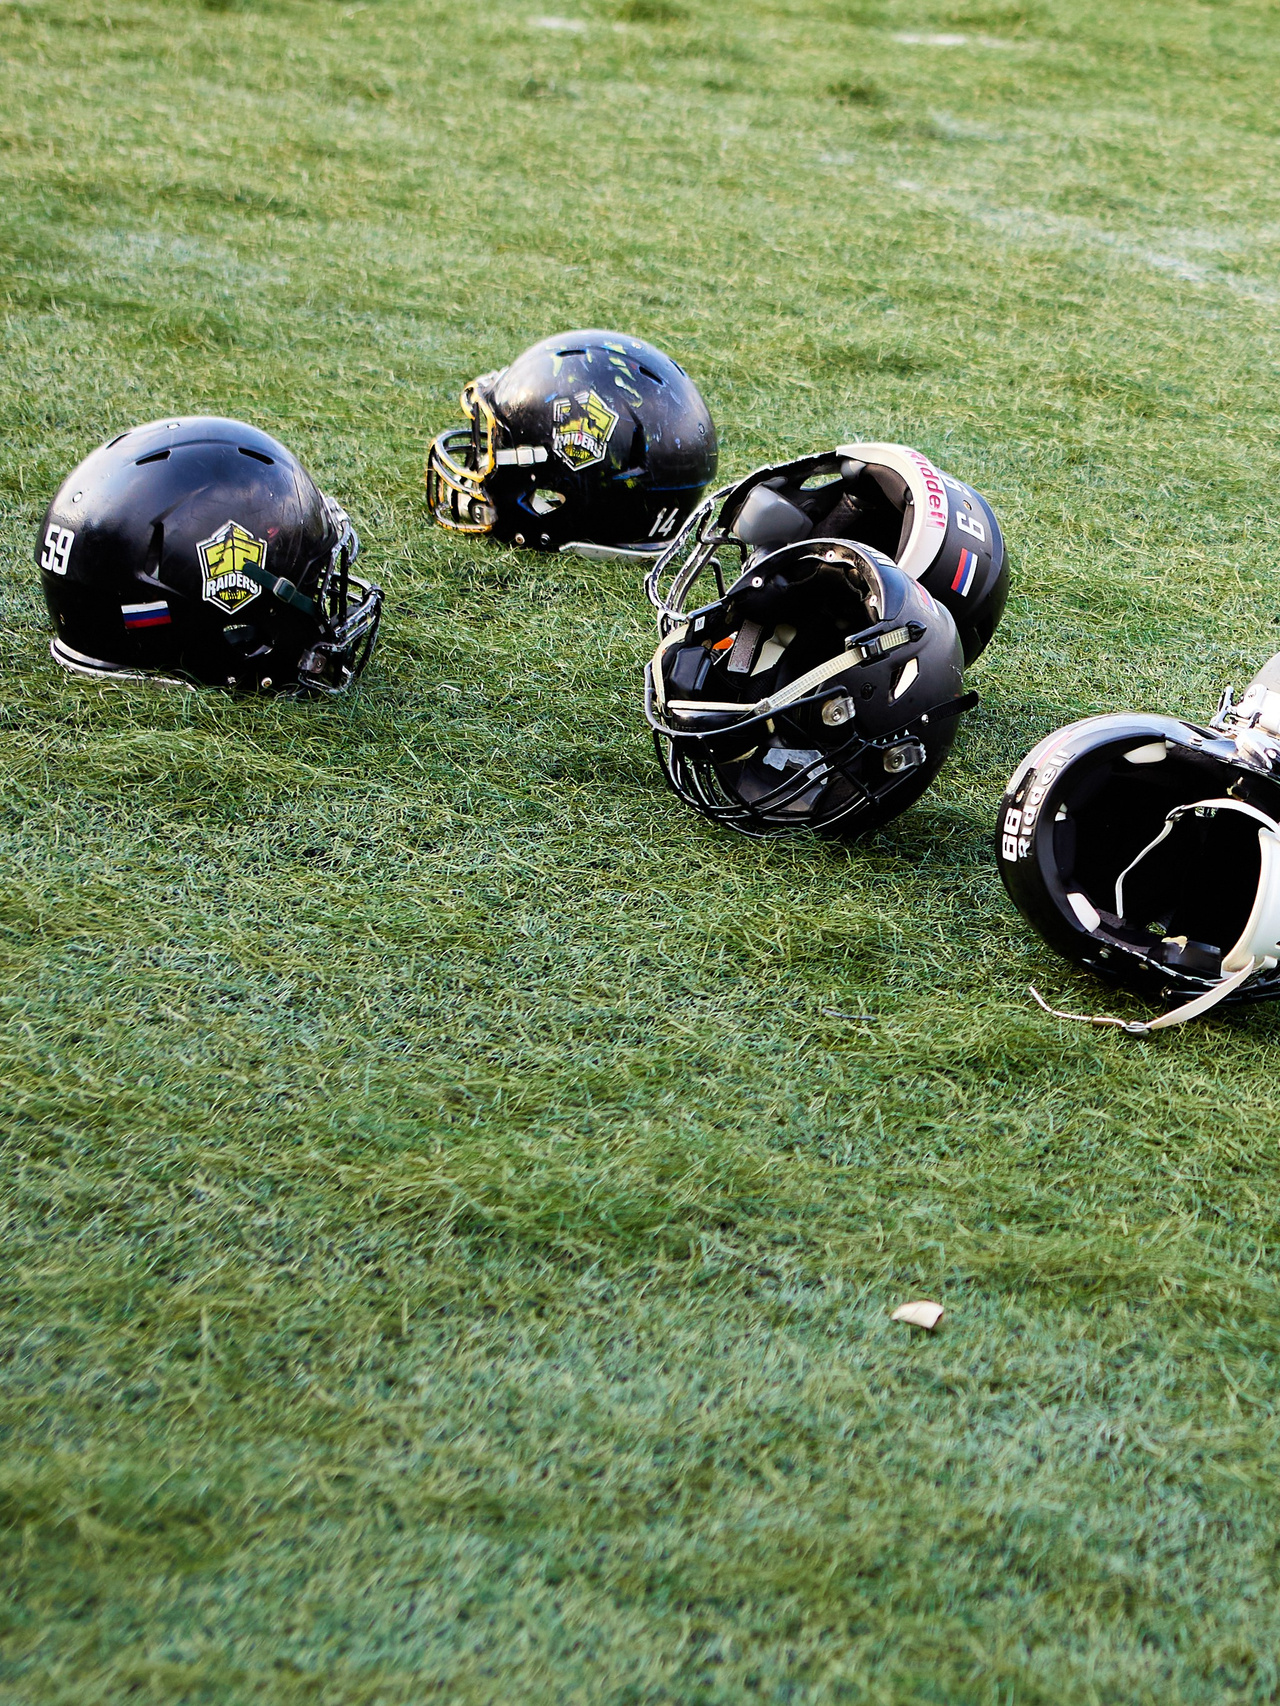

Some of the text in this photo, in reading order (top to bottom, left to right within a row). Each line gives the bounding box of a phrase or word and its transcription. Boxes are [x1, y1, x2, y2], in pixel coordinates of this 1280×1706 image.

[554, 431, 603, 459] RAIDERS
[647, 507, 680, 537] 14
[41, 522, 75, 575] 59
[206, 573, 259, 597] RAIDERS
[1017, 749, 1077, 858] Riddell
